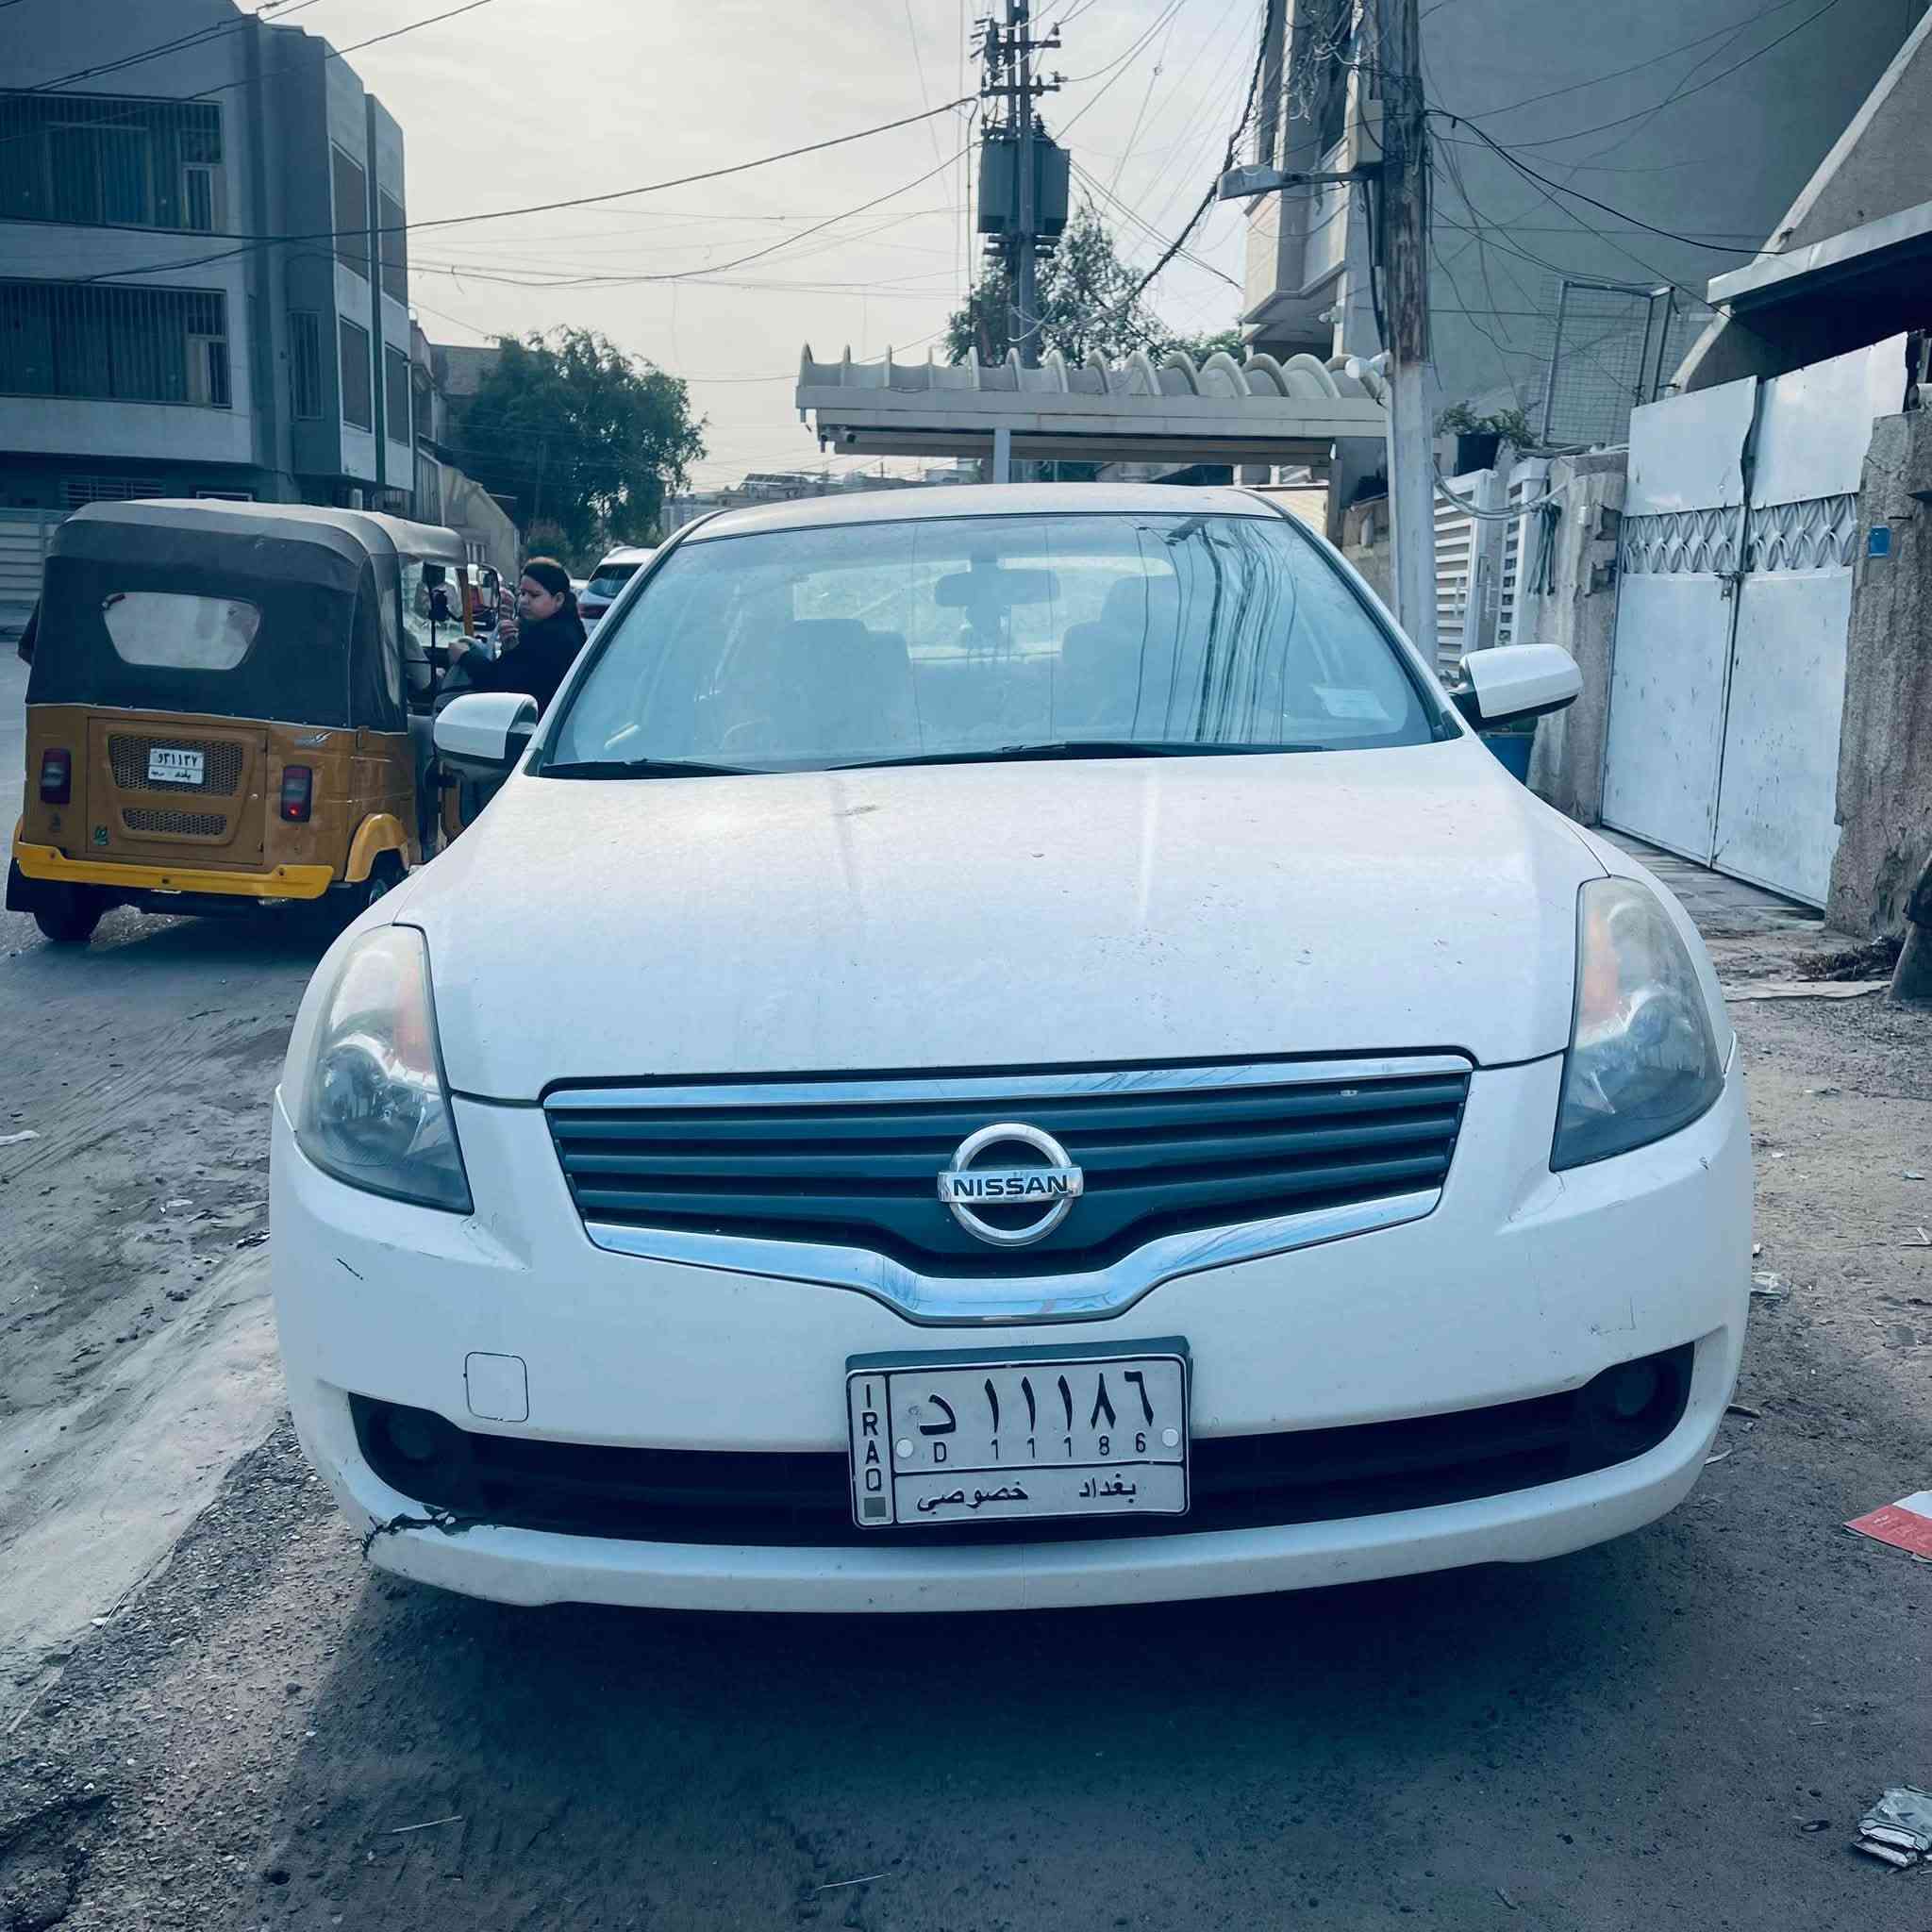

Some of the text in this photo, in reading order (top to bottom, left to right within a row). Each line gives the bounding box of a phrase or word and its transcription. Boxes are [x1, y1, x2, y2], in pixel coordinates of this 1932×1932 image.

[953, 1174, 1068, 1197] NISSAN
[860, 1384, 883, 1492] IRAQ
[917, 1473, 1137, 1515] خصوصي بغداد
